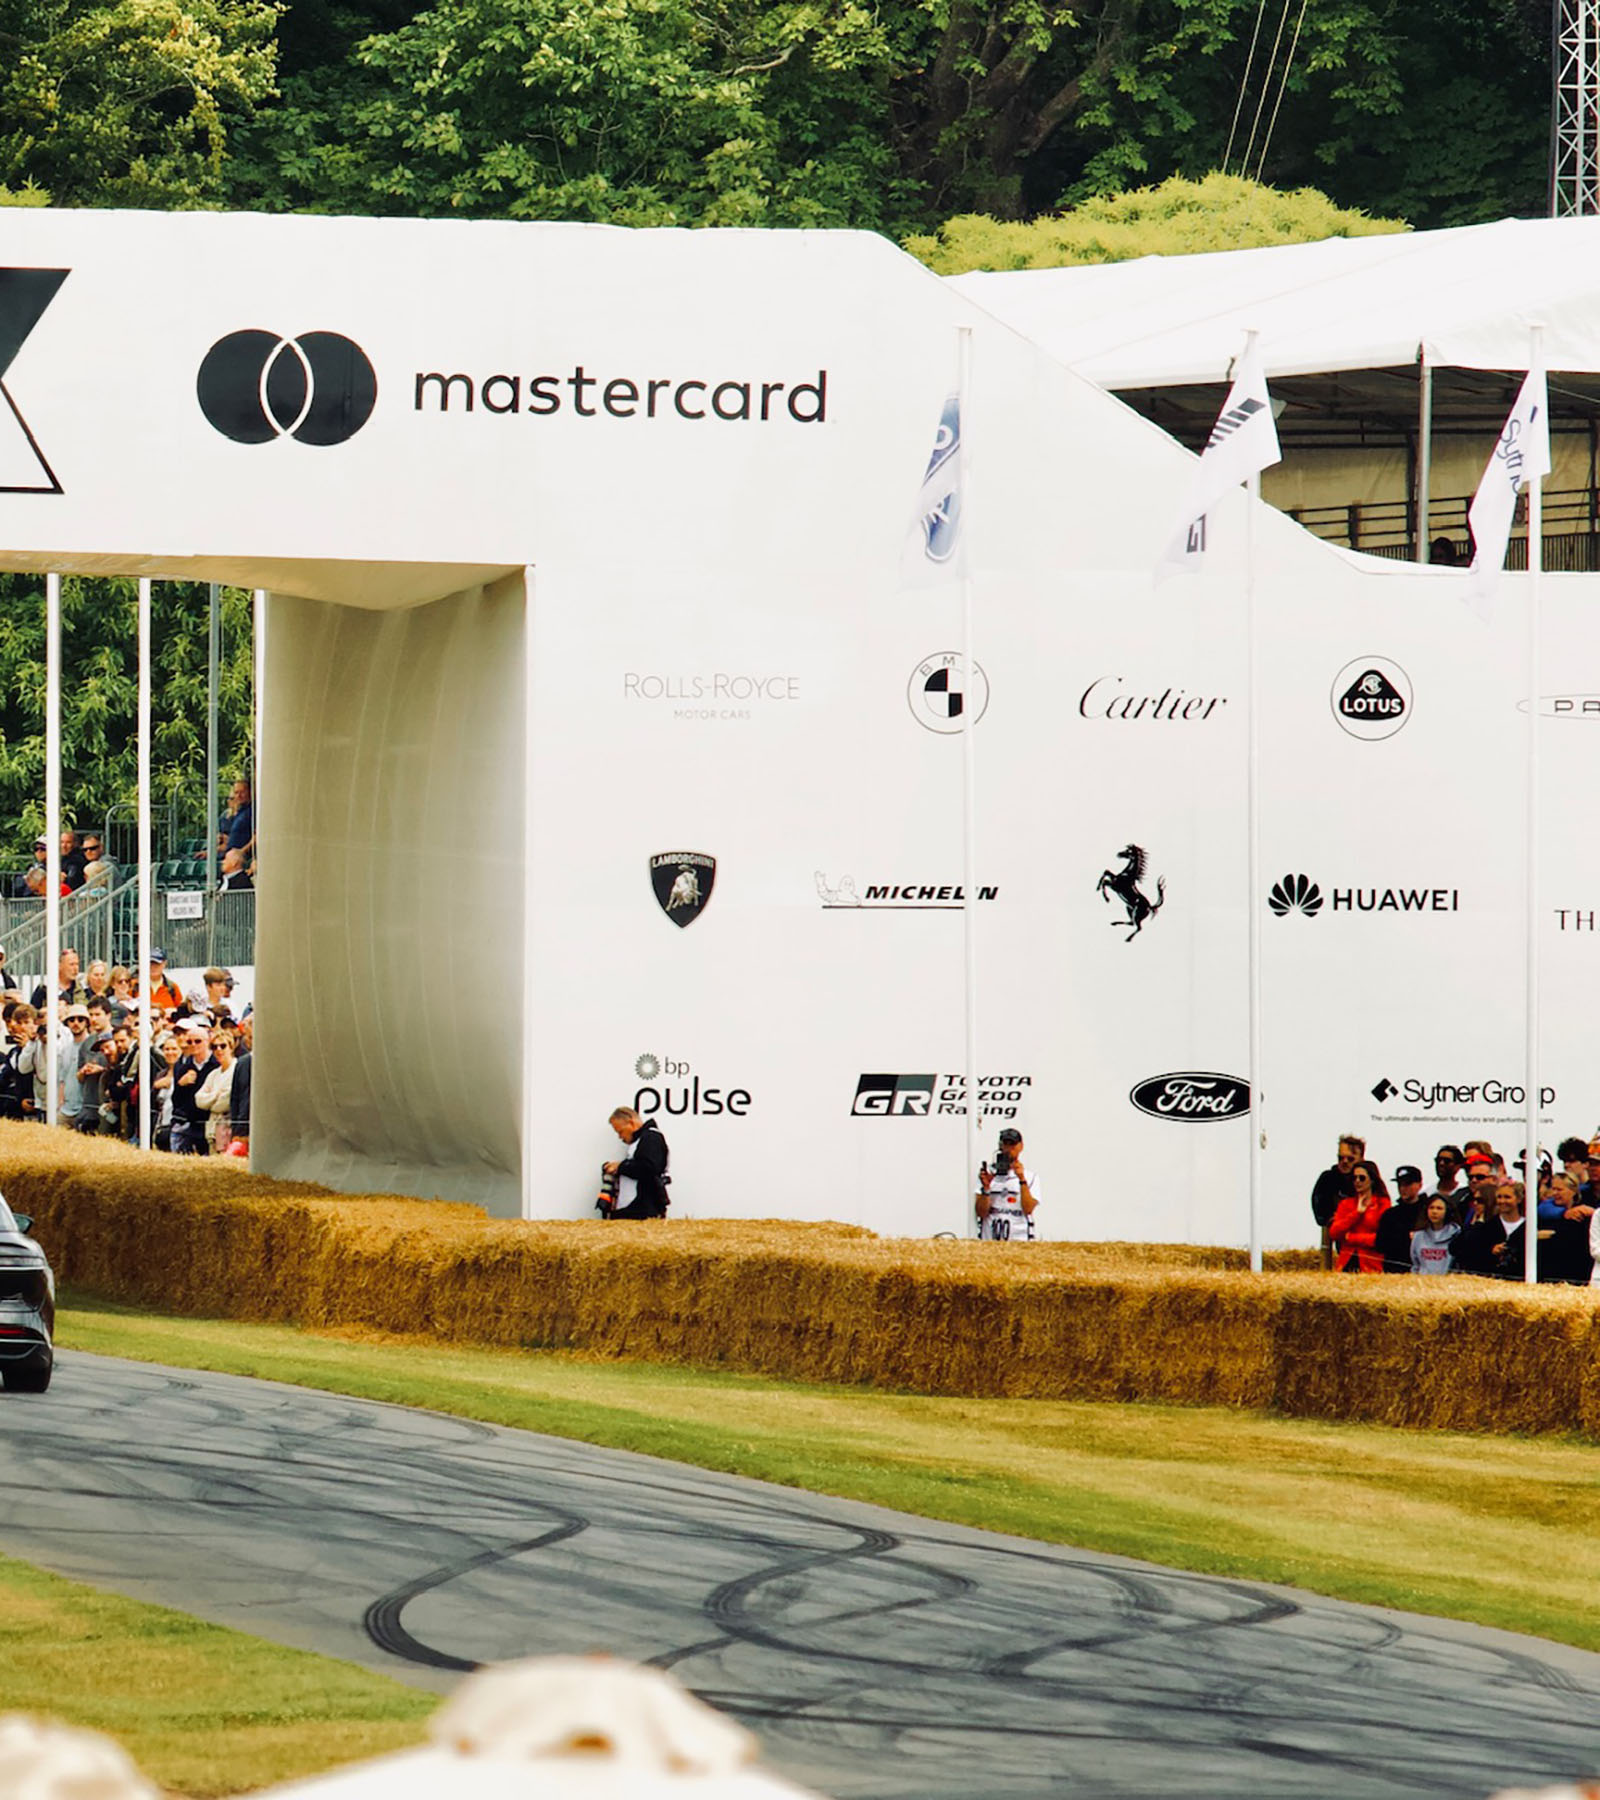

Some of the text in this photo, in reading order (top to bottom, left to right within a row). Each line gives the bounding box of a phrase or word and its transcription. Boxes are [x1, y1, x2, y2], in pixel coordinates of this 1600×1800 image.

[414, 366, 827, 423] mastercard
[919, 655, 979, 677] BM
[624, 673, 800, 700] ROLLS-ROYCE
[1078, 676, 1227, 720] Cartier
[673, 709, 751, 720] MOTOR CARS
[1343, 697, 1402, 713] LOTUS
[865, 885, 999, 900] MICHELN
[1332, 889, 1459, 911] HUAWEI
[1553, 909, 1600, 931] TH
[664, 1056, 691, 1079] bp
[633, 1075, 752, 1116] pulse
[854, 1090, 932, 1115] GR
[1156, 1079, 1236, 1113] Ford
[1403, 1079, 1556, 1109] Sytner Grop
[937, 1103, 1018, 1119] Raing
